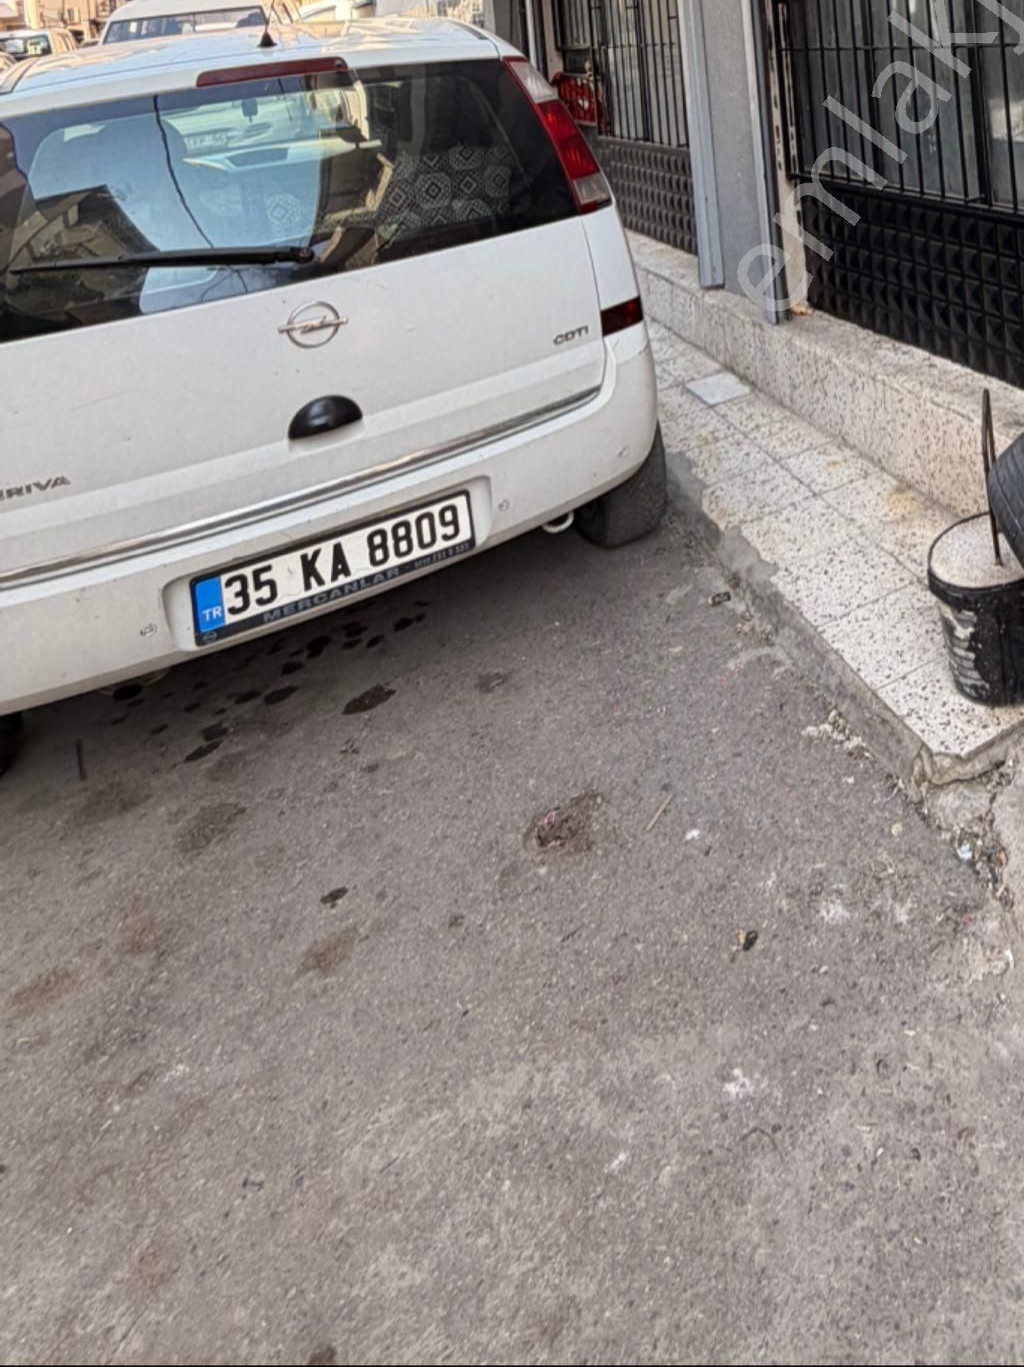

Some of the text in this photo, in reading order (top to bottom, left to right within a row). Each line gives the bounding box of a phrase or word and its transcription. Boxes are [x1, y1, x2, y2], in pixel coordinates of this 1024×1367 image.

[553, 324, 589, 346] CDTI
[225, 565, 278, 615] 35
[300, 543, 351, 591] KA
[367, 504, 460, 567] 8809
[202, 606, 222, 622] TR
[263, 568, 400, 623] MERCANLAR
